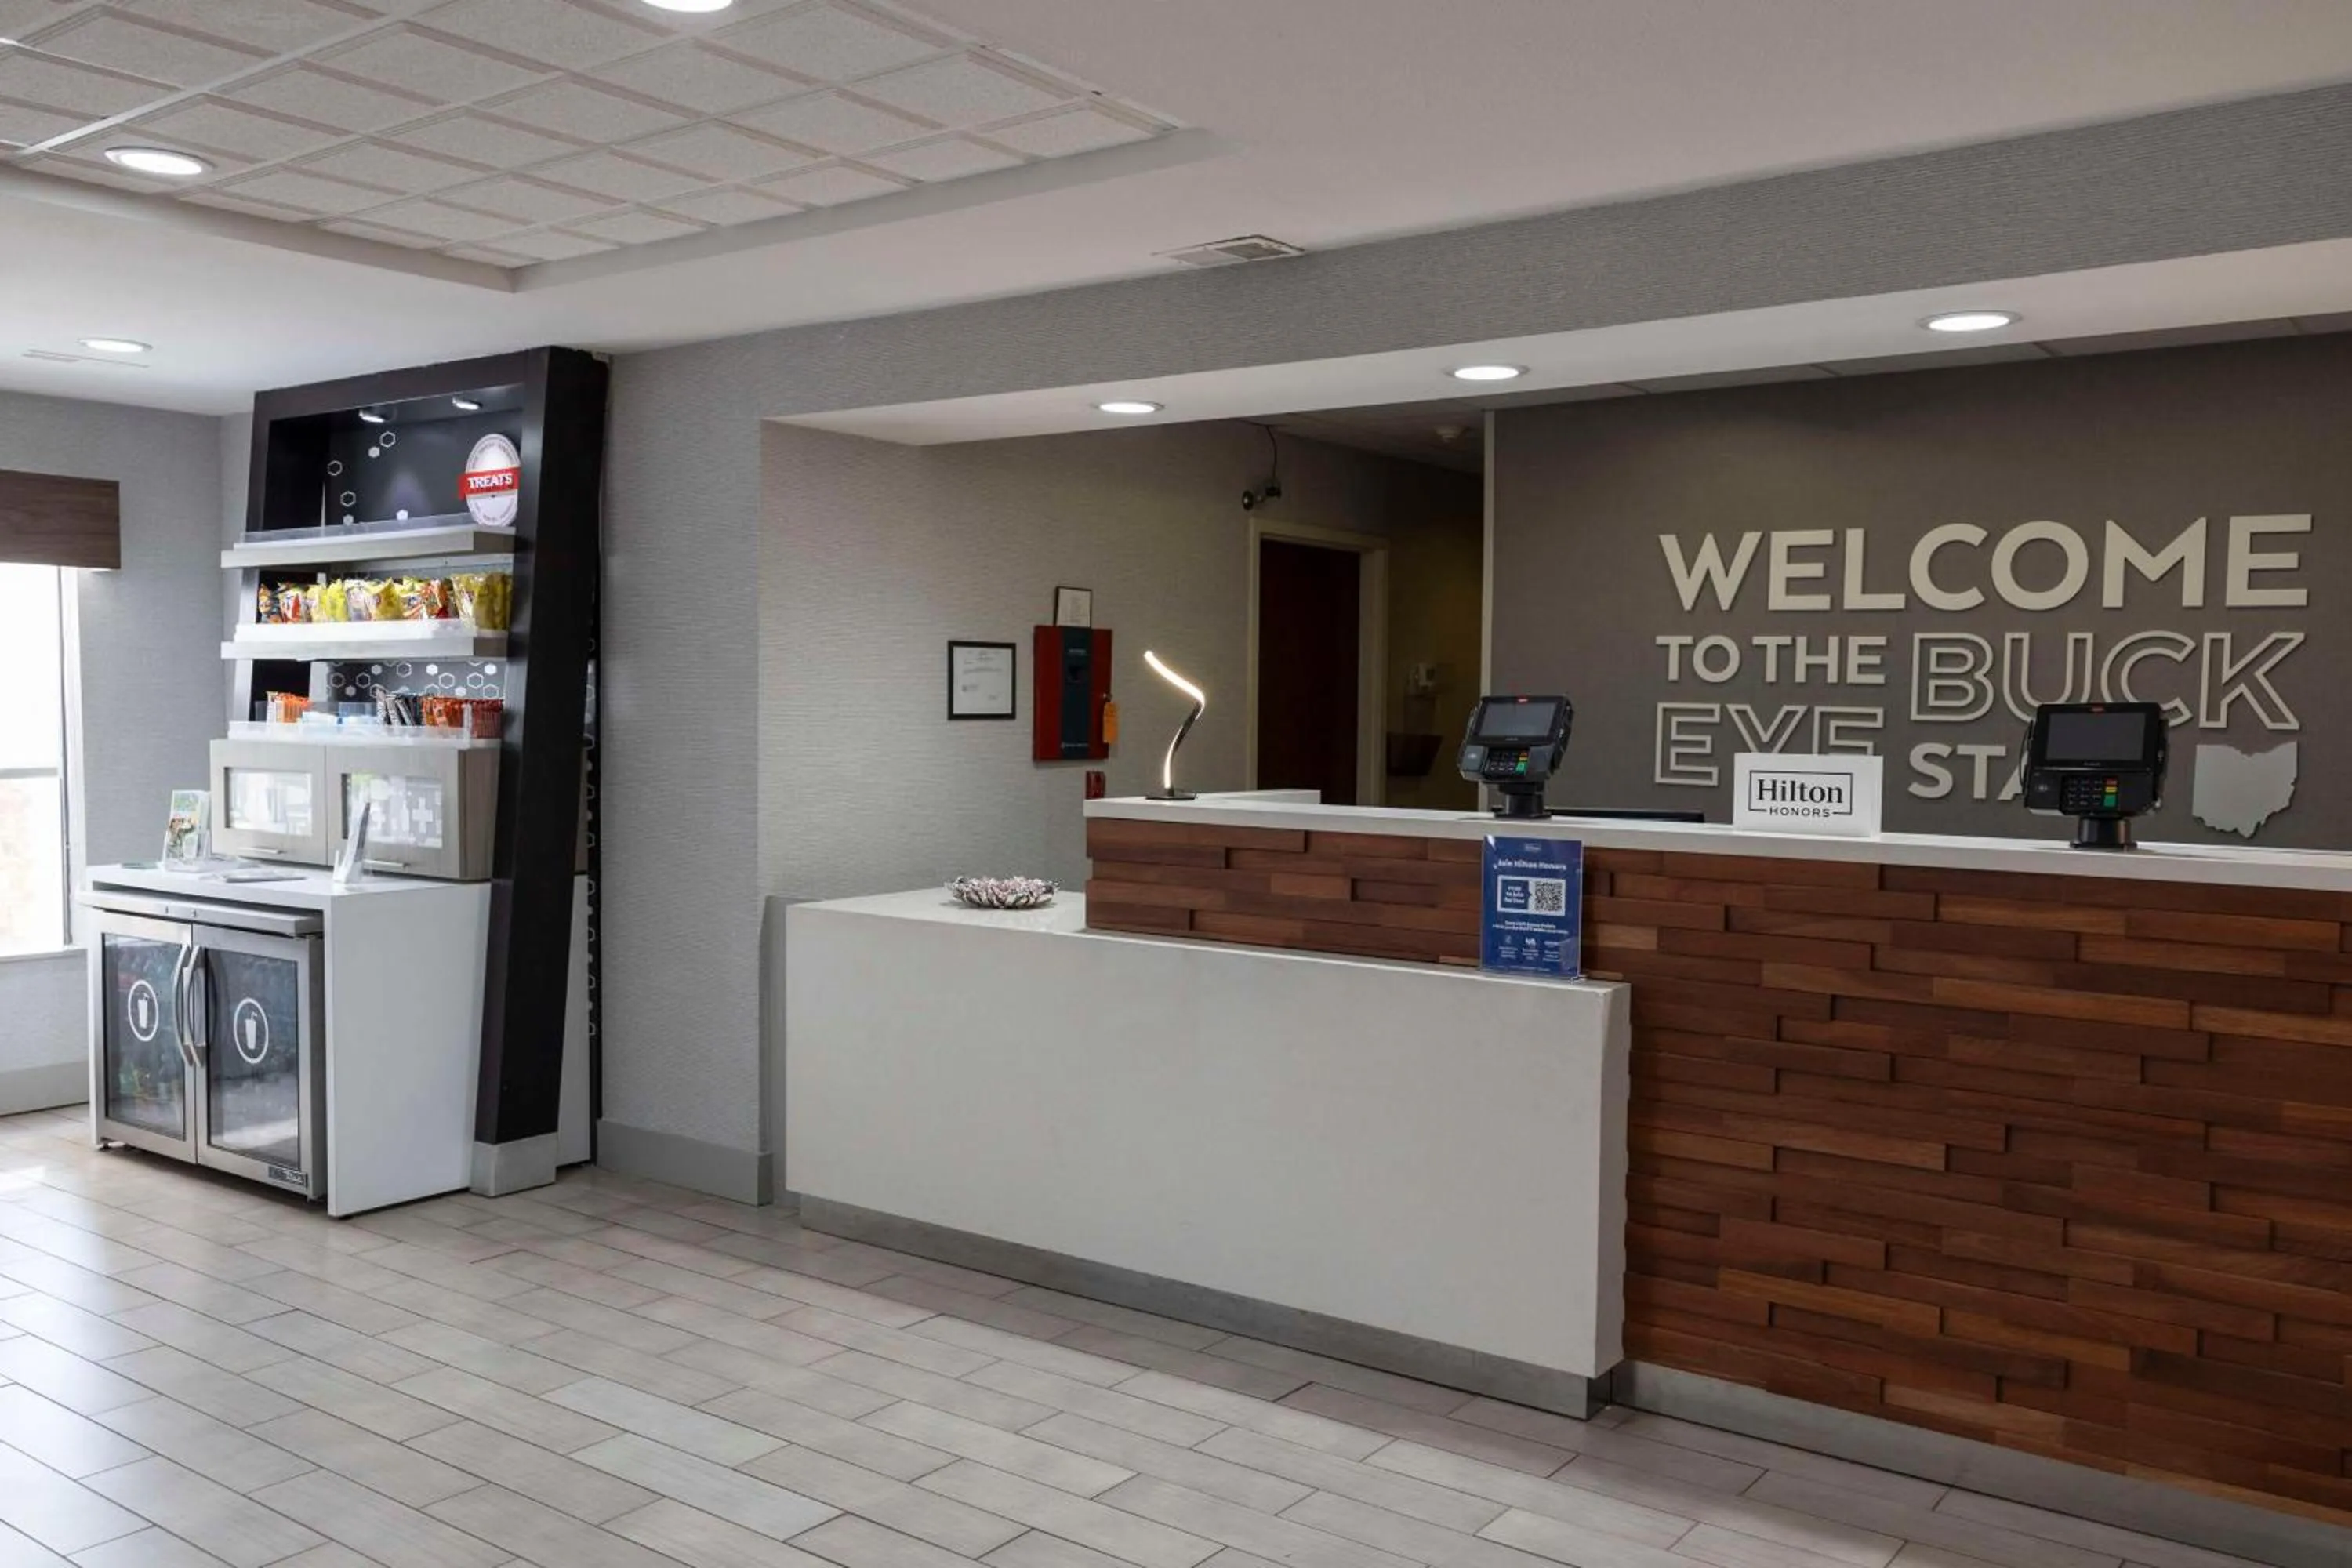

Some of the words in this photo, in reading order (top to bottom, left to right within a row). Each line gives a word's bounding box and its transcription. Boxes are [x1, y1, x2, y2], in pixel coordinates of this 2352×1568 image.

[468, 474, 512, 488] TREATS
[1658, 514, 2313, 612] WELCOME
[1655, 634, 1741, 684] TO
[1751, 635, 1888, 684] THE
[1910, 630, 2306, 730] BUCK
[1757, 779, 1843, 804] Hilton
[1769, 806, 1831, 817] HONORS
